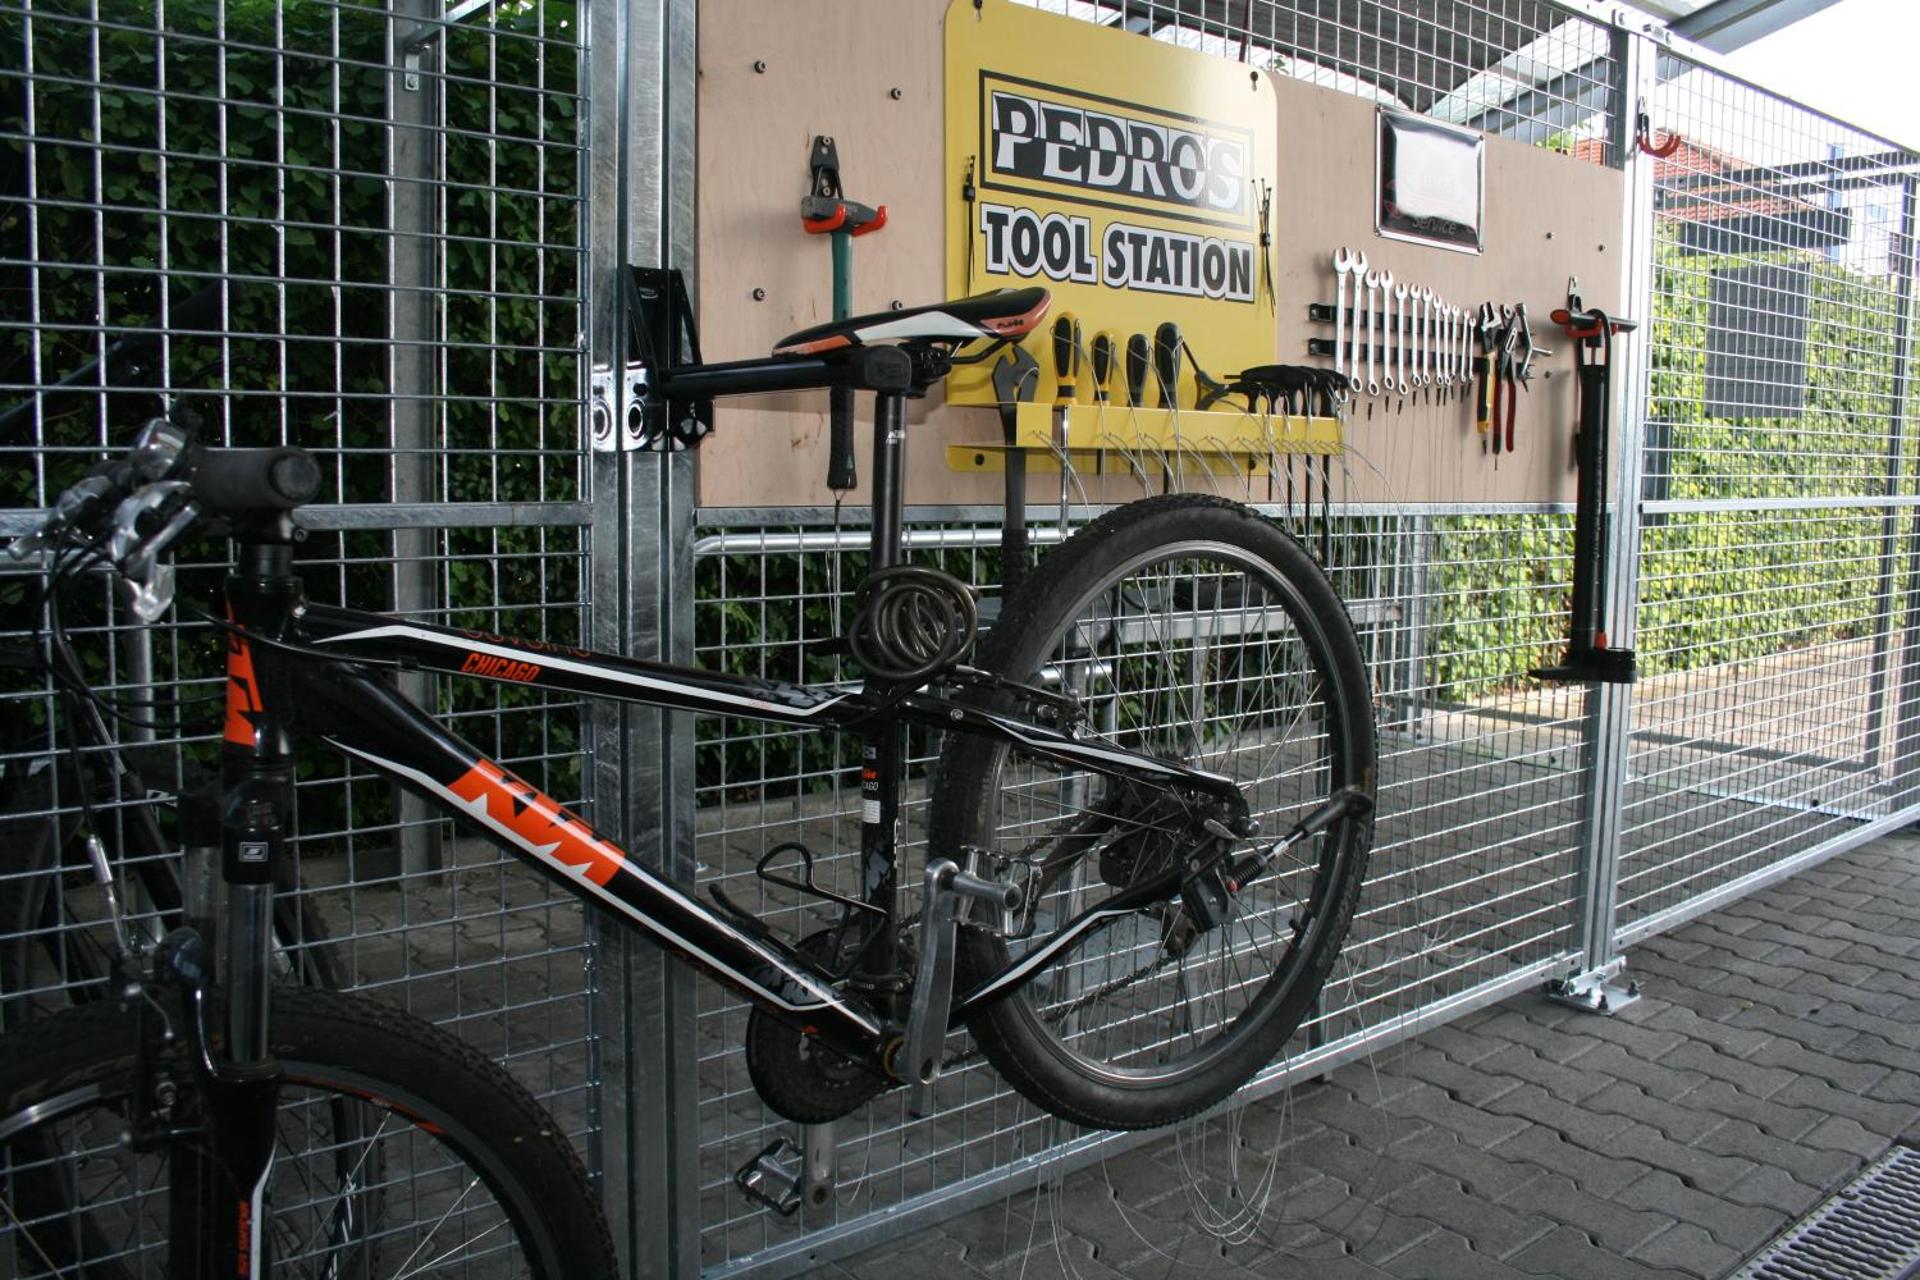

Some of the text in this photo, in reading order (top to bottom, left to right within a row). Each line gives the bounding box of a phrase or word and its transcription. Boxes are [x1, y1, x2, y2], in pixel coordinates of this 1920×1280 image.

[985, 209, 1252, 297] TOOL STATION
[461, 651, 542, 683] CHICAGO
